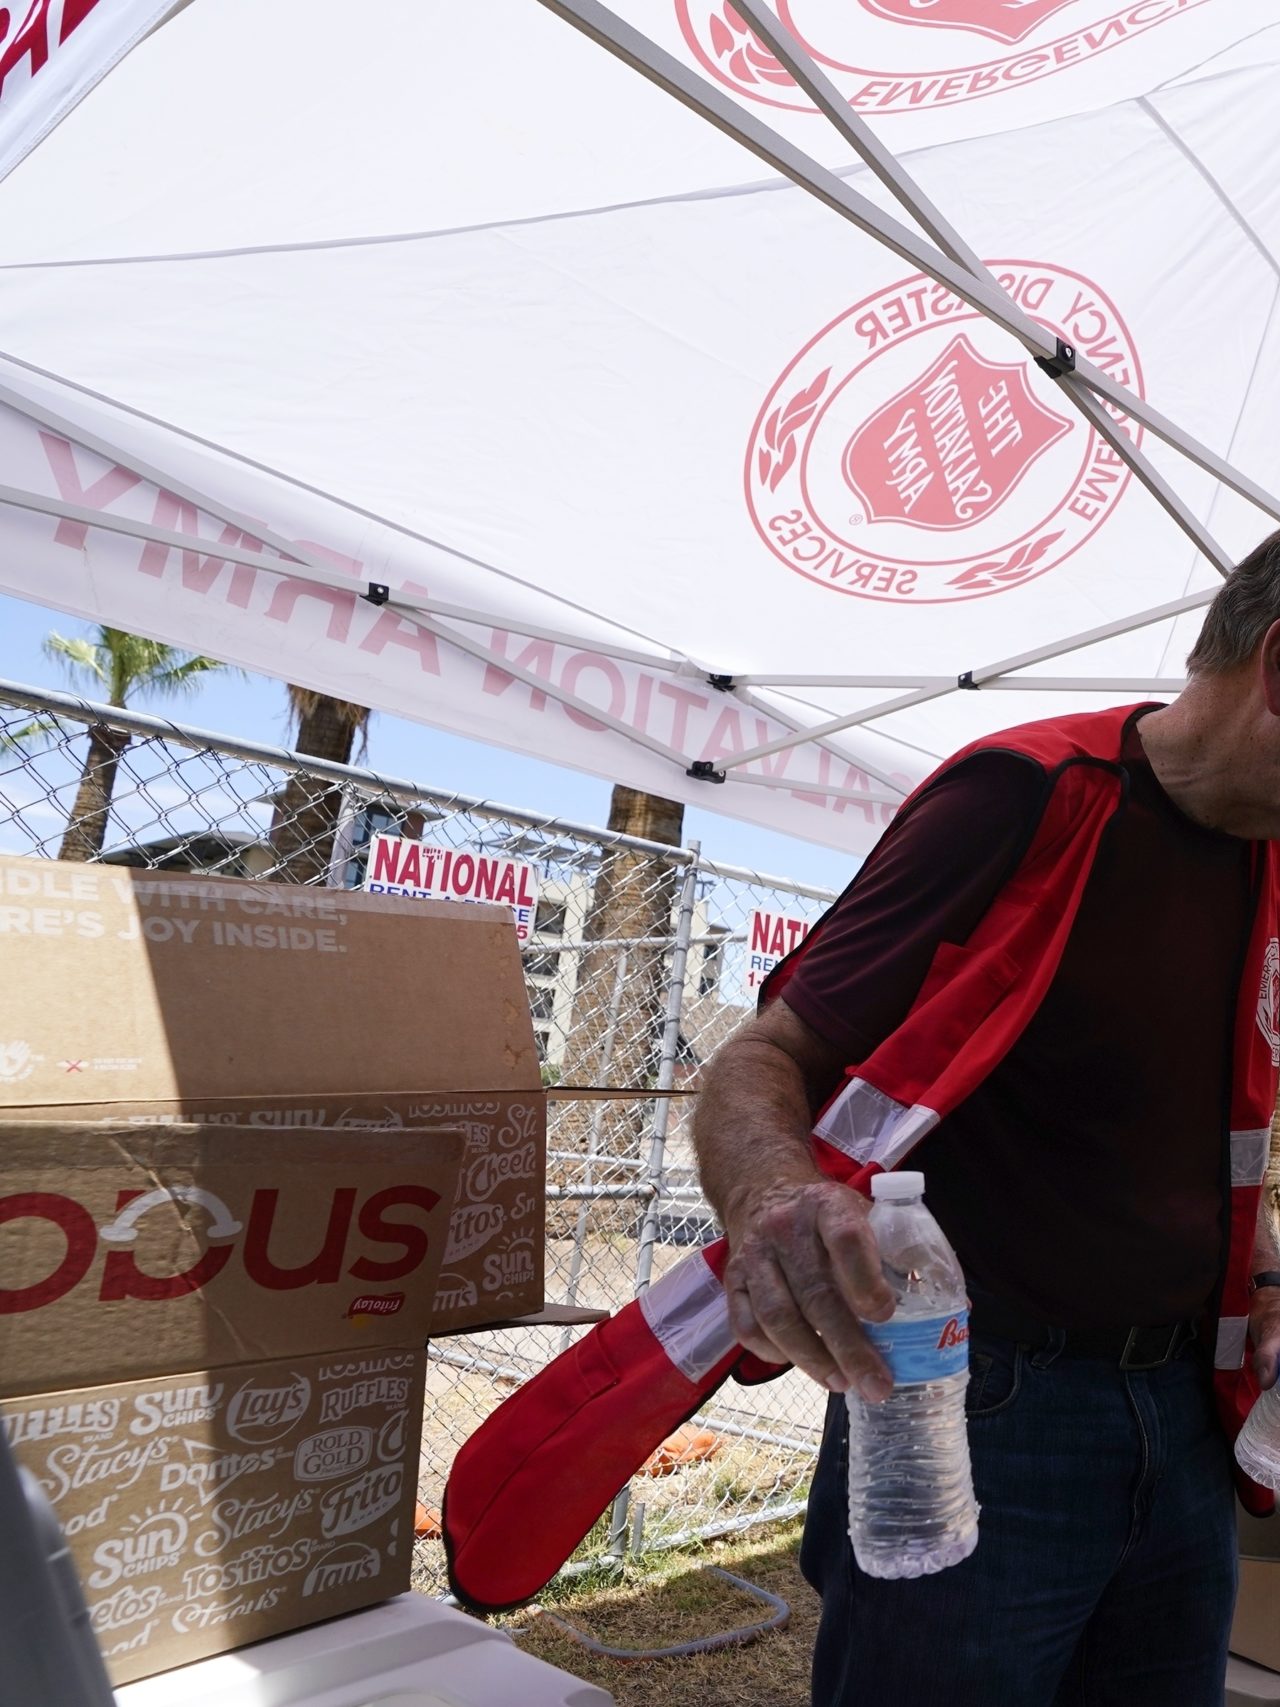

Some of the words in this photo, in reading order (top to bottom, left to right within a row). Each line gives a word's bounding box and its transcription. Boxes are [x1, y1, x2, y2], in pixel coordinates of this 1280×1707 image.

[373, 838, 534, 908] NATIONAL
[0, 867, 99, 903] DLE
[111, 877, 227, 912] WITH
[237, 890, 350, 926] CARE,
[117, 914, 202, 946] JOY
[213, 920, 350, 953] INSIDE.
[129, 1384, 225, 1436] Sun
[161, 1408, 217, 1428] CHIPS
[233, 1383, 306, 1426] Lay's
[321, 1378, 408, 1423] RUFFLES
[303, 1446, 364, 1475] GOLD
[312, 1430, 363, 1452] ROLD
[39, 1436, 170, 1505] Stacy's
[160, 1448, 277, 1493] Doritos
[194, 1487, 315, 1557] Stacy's
[88, 1520, 187, 1589] Sun
[121, 1552, 181, 1578] CHIPS
